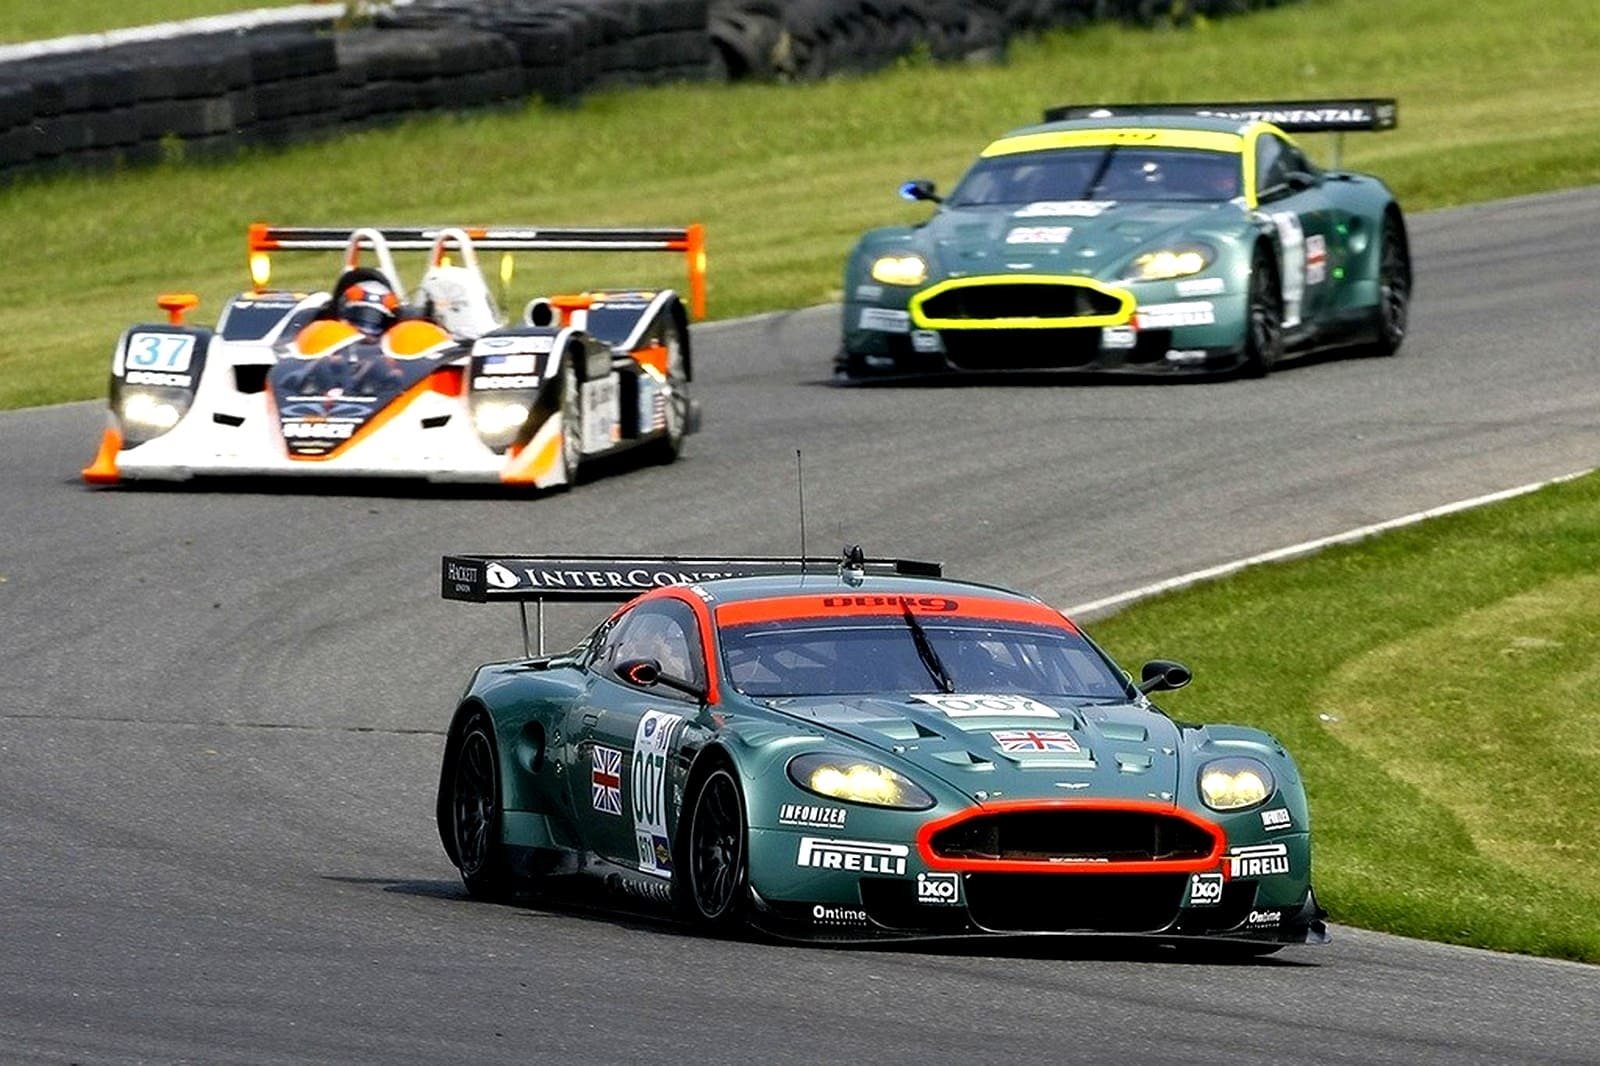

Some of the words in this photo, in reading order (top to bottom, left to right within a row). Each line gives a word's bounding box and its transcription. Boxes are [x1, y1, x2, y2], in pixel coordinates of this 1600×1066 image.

[134, 336, 189, 367] 37
[936, 699, 1036, 712] 007
[631, 749, 665, 826] 007
[779, 804, 847, 824] INFONIZER
[797, 837, 909, 875] PIRELLI
[1230, 843, 1289, 877] PIRELLI
[812, 904, 867, 920] Ontime
